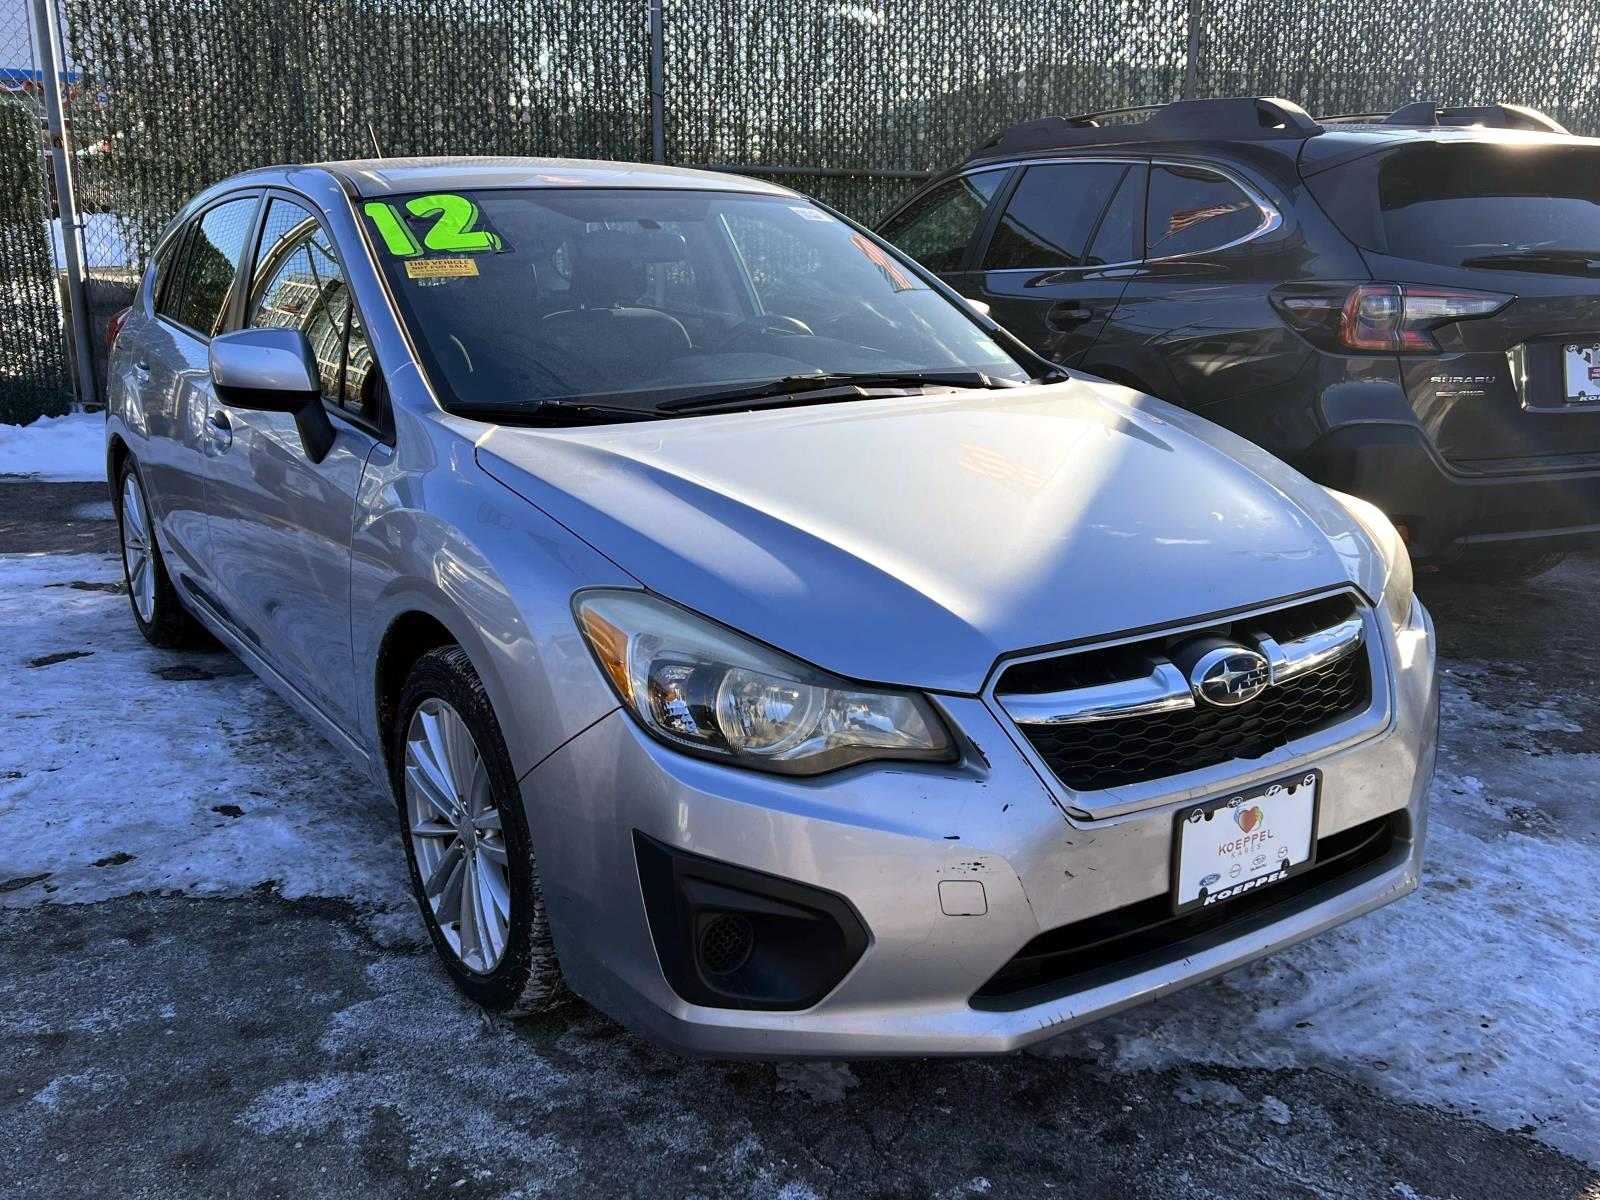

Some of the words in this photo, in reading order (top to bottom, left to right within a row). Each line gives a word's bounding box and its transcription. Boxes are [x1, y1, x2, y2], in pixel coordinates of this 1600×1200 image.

[364, 194, 502, 257] 12
[1430, 376, 1496, 384] SUBARU
[1218, 829, 1274, 856] KOEPPEL
[1203, 870, 1289, 906] KOEPPEL
